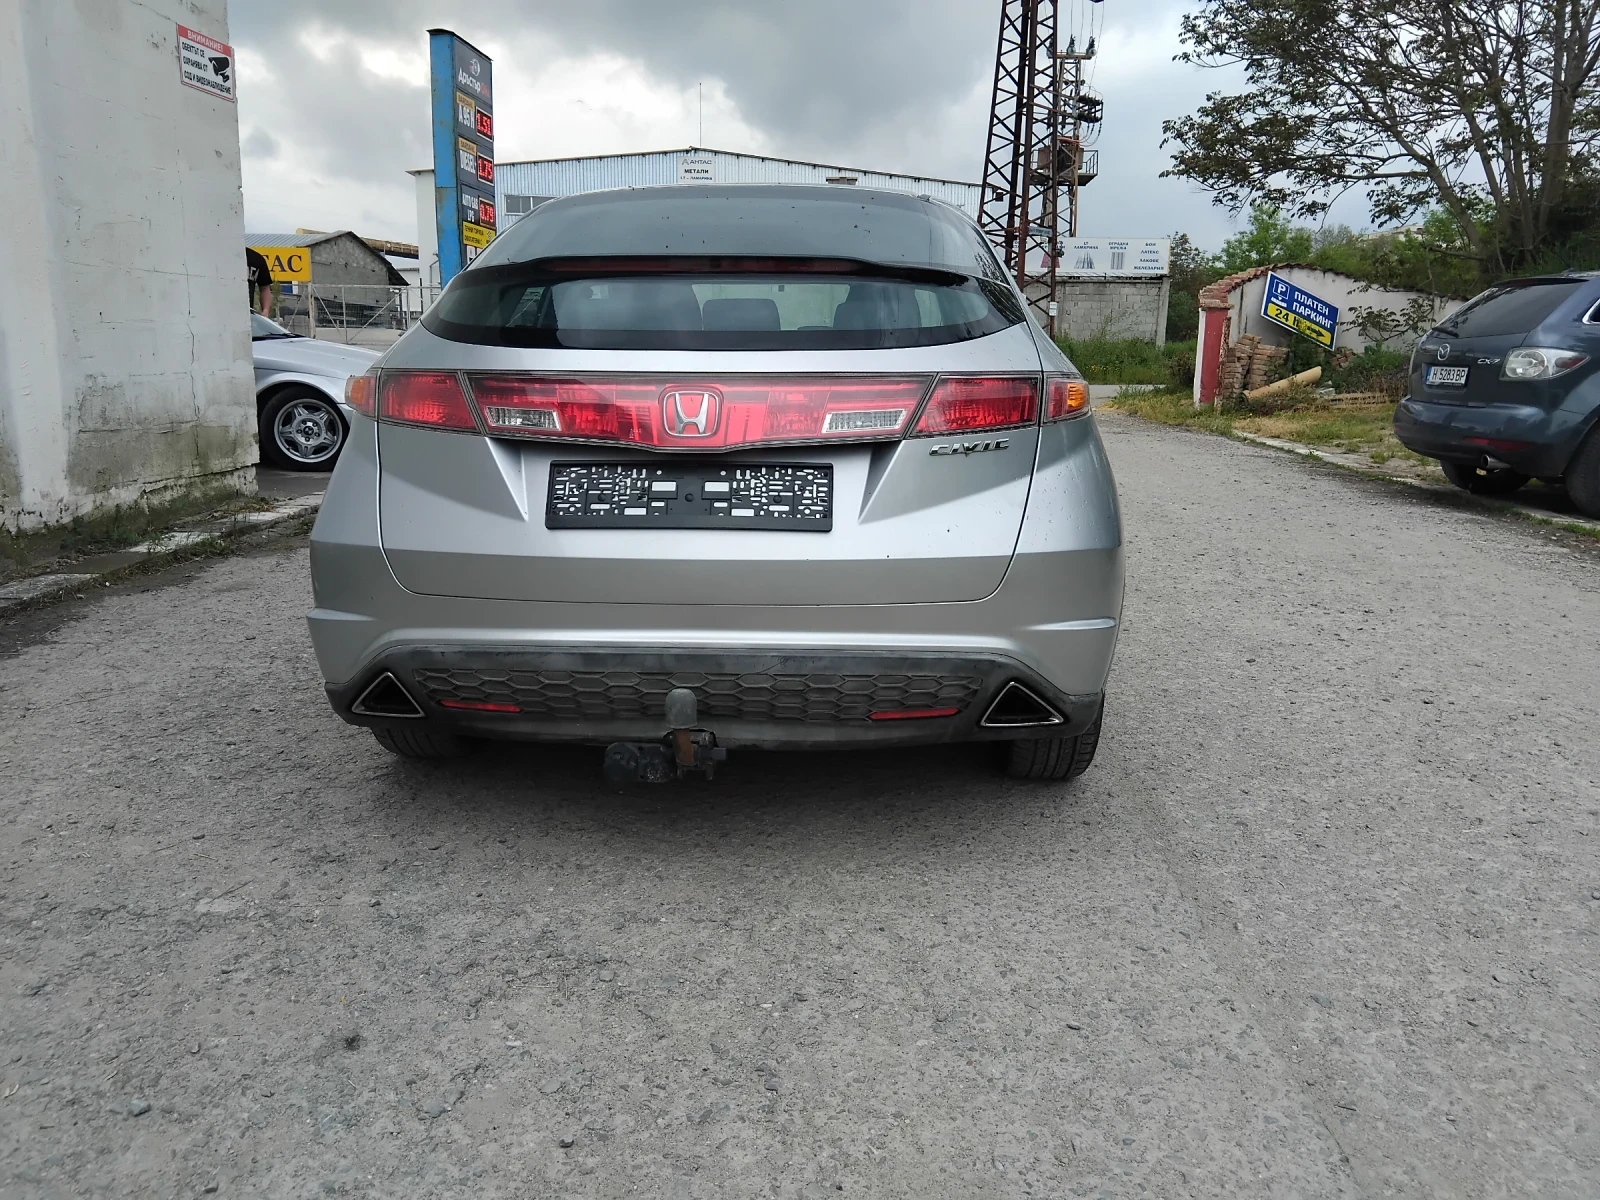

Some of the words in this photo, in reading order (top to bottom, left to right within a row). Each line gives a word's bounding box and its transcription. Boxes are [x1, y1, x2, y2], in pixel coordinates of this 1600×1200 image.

[182, 41, 199, 56] ОБЕКТЪТ
[200, 49, 205, 58] СЕ
[187, 30, 224, 53] ВНИМАНИЕ!
[183, 56, 203, 71] ОХРАНЯВА
[203, 64, 208, 73] ОТ
[458, 67, 481, 94] Дръстър
[477, 113, 492, 136] 1.51
[478, 159, 493, 180] 1.75
[467, 209, 475, 223] LPG
[480, 203, 495, 223] 0.79
[1277, 283, 1287, 294] P
[1294, 291, 1329, 316] ПЛАТЕН
[1275, 308, 1290, 323] 24
[1292, 301, 1334, 329] ПАРКИНГ
[929, 438, 1010, 457] CIVIC
